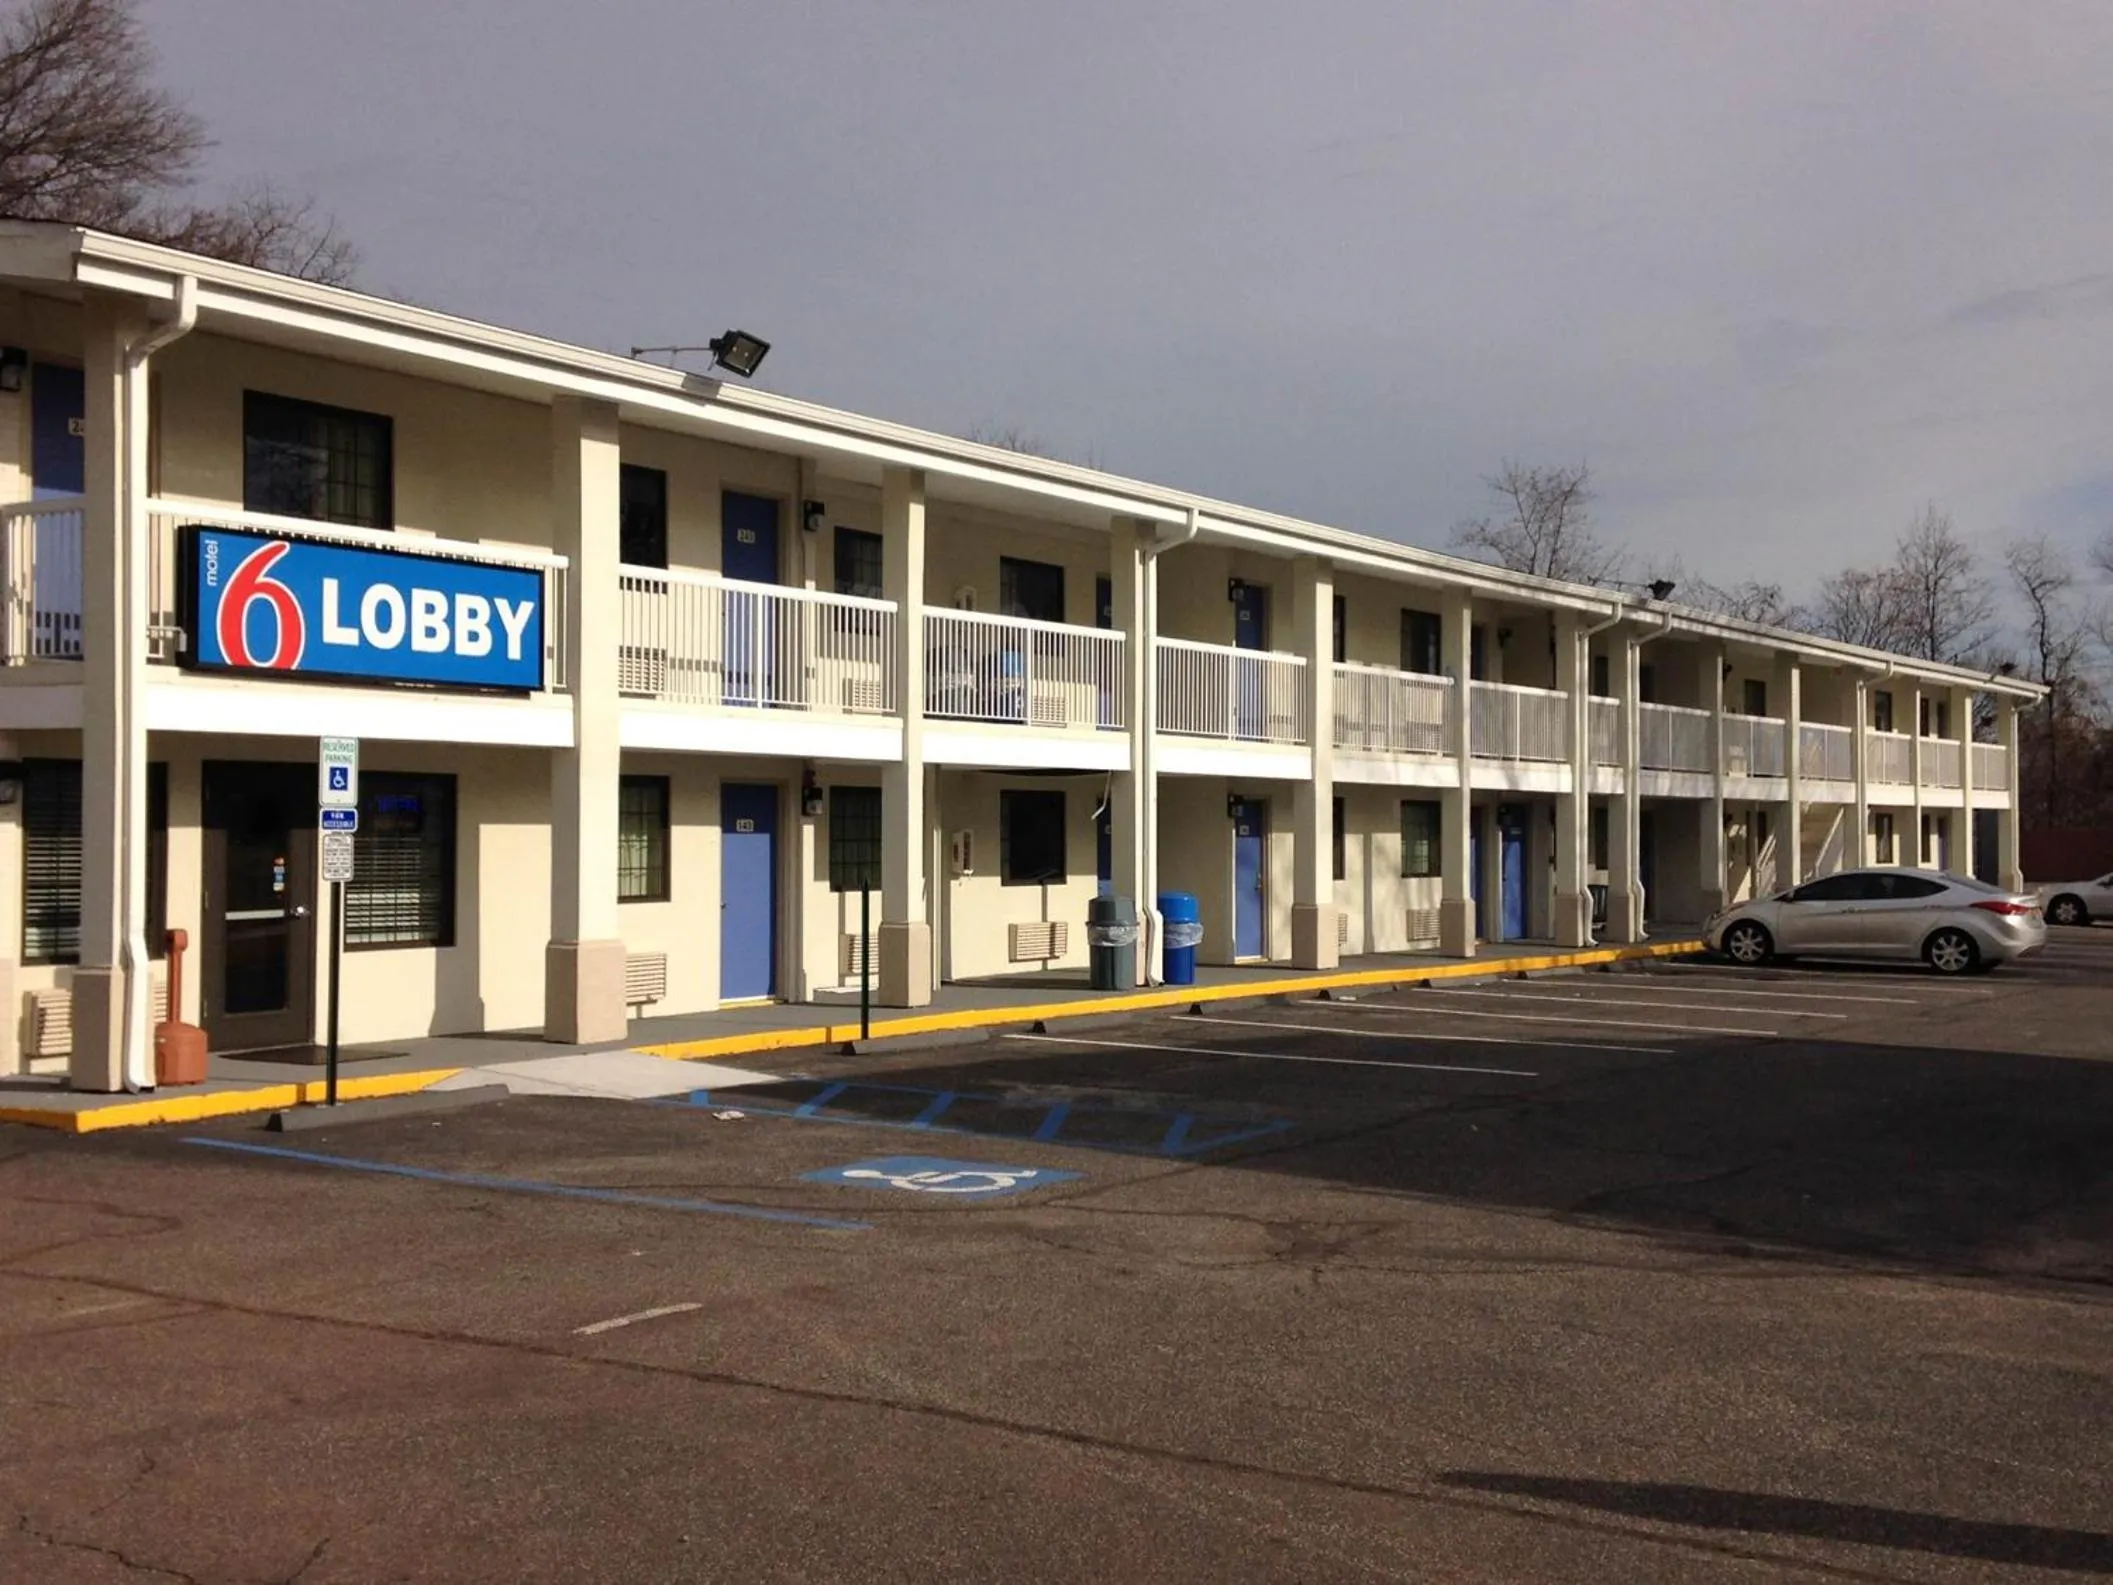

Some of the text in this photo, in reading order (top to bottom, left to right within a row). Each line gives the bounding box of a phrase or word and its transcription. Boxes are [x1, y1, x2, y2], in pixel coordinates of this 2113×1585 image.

[204, 539, 305, 670] motel 6
[322, 577, 535, 661] LOBBY
[325, 753, 353, 763] PARKING
